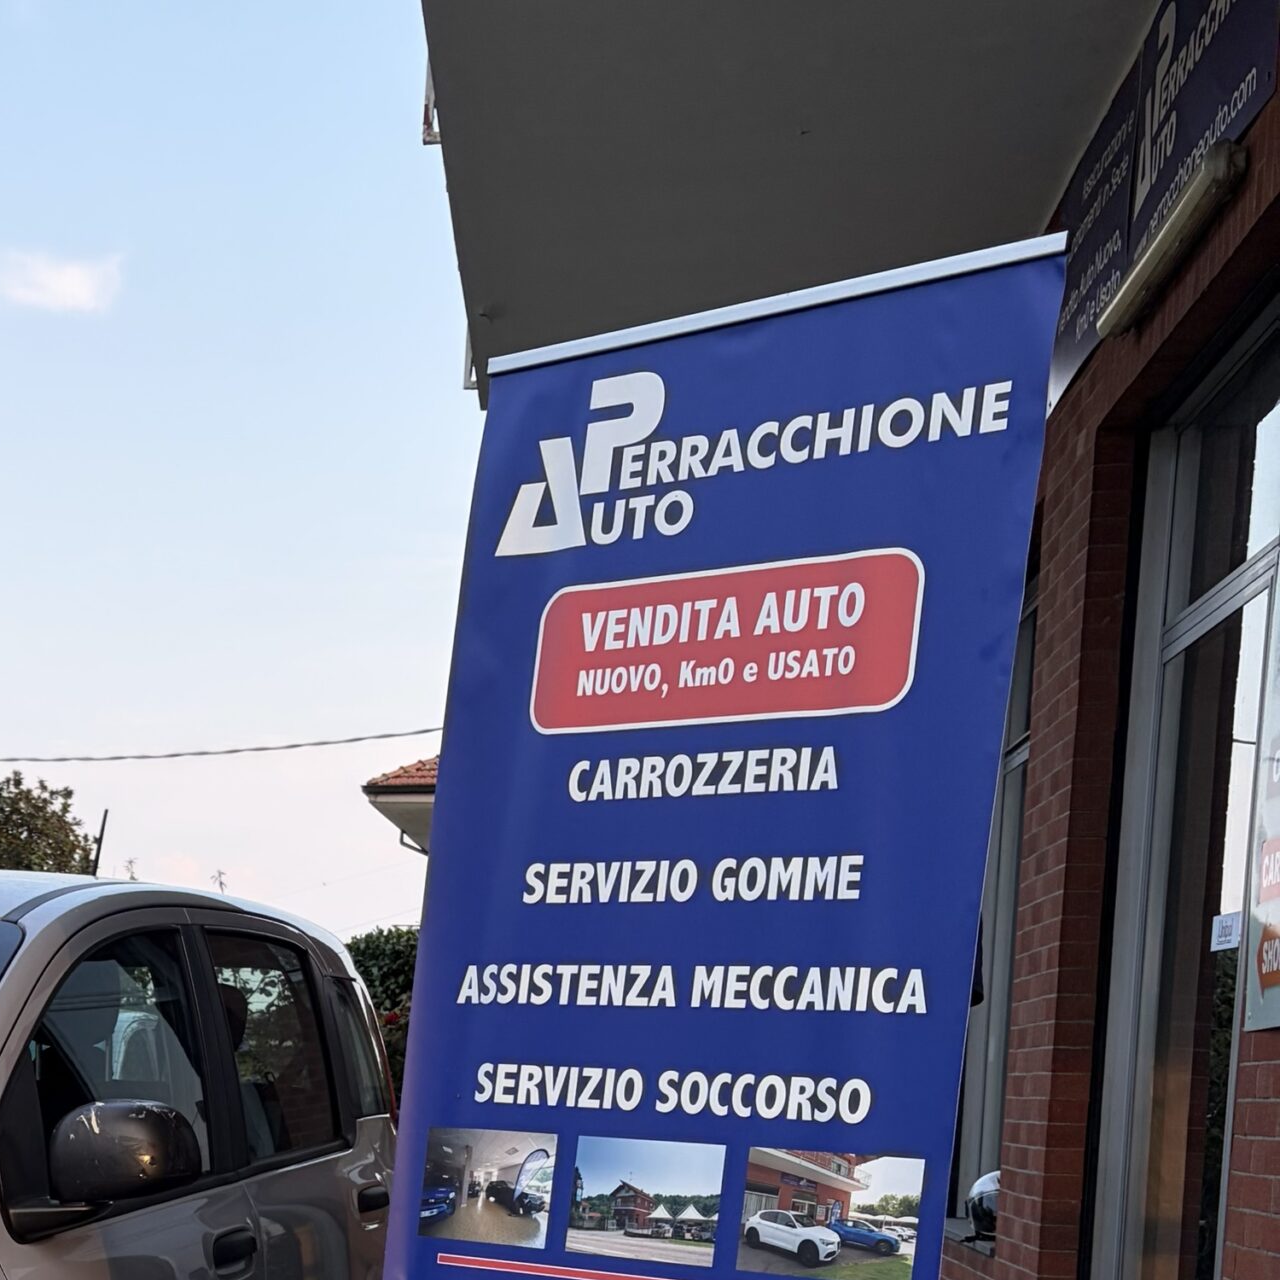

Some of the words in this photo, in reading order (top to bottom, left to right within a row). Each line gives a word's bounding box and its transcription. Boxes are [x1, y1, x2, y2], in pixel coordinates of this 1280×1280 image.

[1151, 0, 1236, 137] PERRACCH
[1132, 86, 1178, 222] AUTO
[579, 371, 1013, 496] PERRACCHIONE
[494, 436, 694, 557] AUTO
[581, 596, 741, 652] VENDITA
[753, 581, 866, 636] AUTO
[576, 663, 669, 699] NUOVO,
[678, 657, 735, 689] Km0
[742, 662, 759, 683] e
[767, 645, 856, 681] USATO
[568, 745, 838, 803] CARROZZERIA
[522, 859, 698, 904] SERVIZIO
[711, 854, 864, 902] GOMME
[1261, 938, 1280, 974] SHO
[456, 963, 676, 1008] ASSISTENZA
[690, 965, 927, 1014] MECCANICA
[474, 1062, 644, 1111] SERVIZIO
[655, 1070, 872, 1124] SOCCORSO
